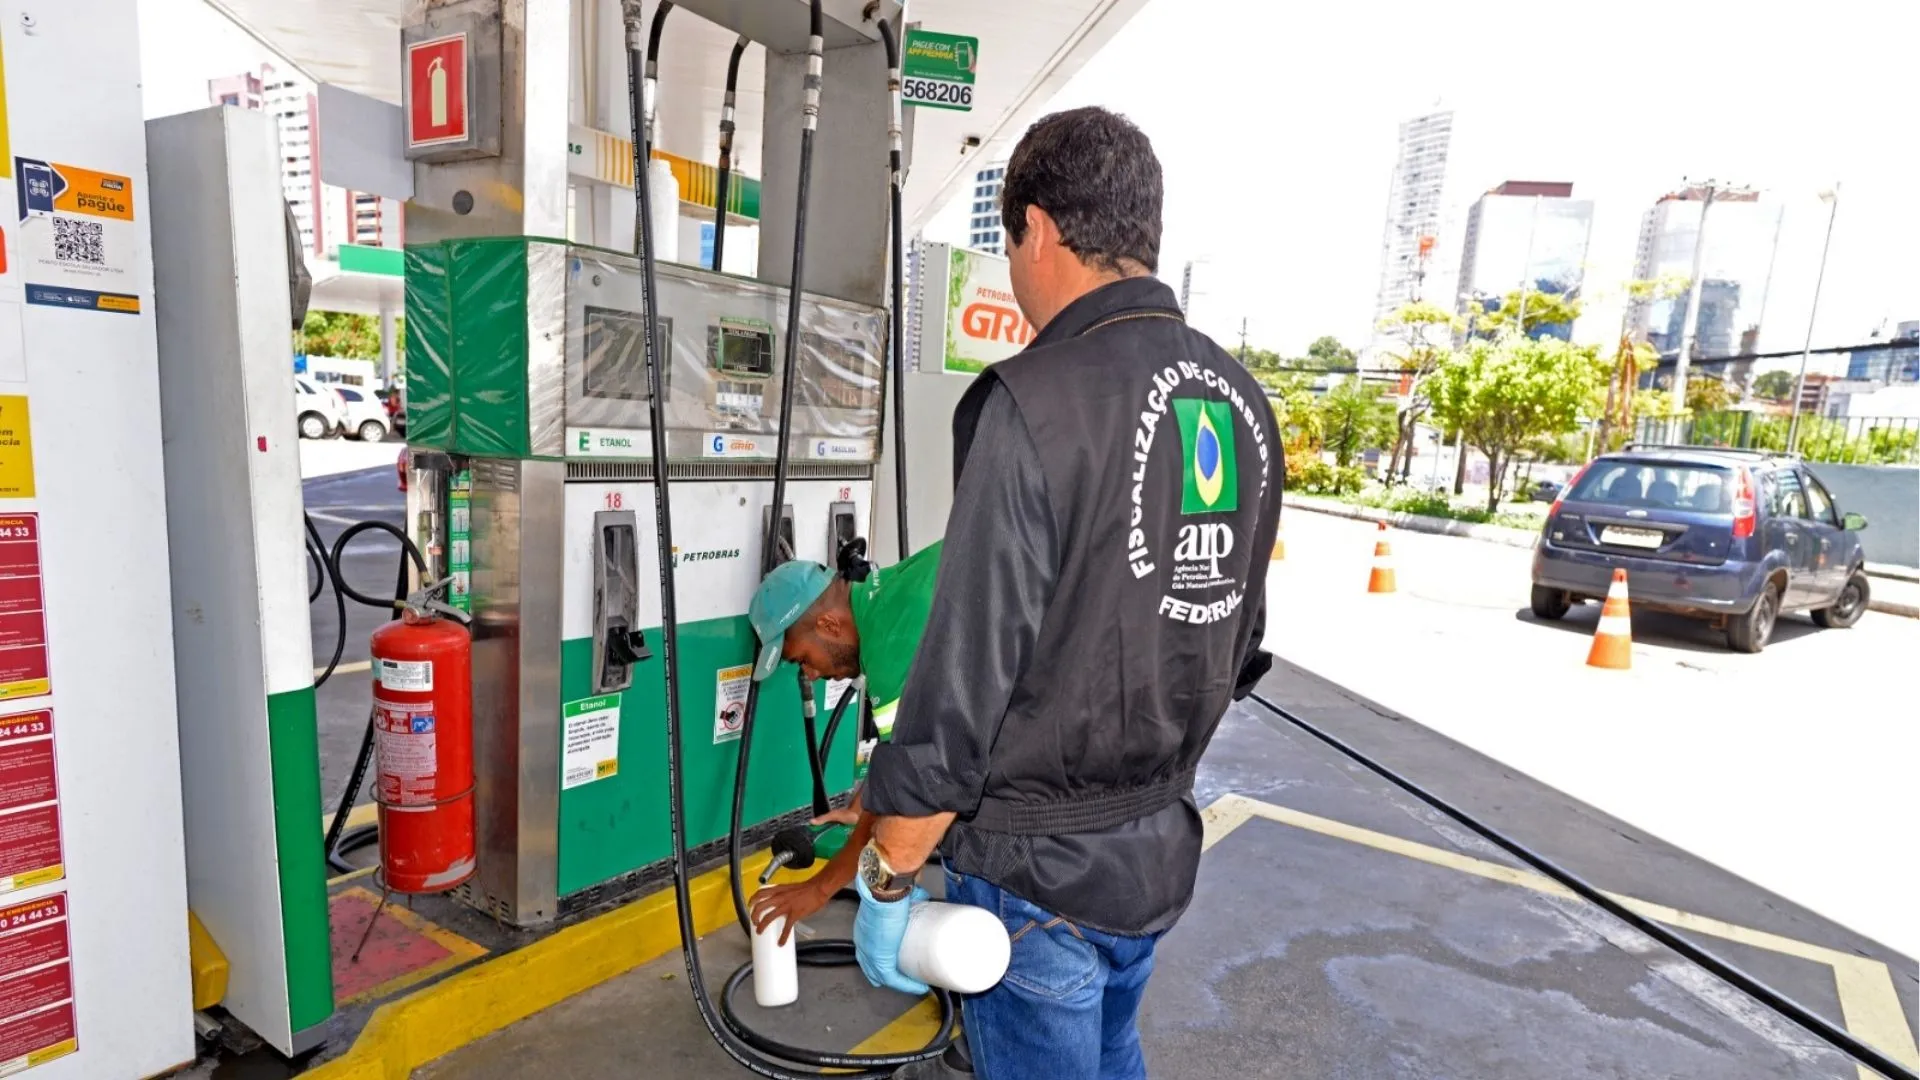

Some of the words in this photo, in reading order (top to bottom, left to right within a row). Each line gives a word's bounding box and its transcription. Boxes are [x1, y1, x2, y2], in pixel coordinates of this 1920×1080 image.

[903, 79, 972, 105] 568206
[77, 198, 125, 212] pague
[976, 287, 1017, 303] PETROBRA
[579, 432, 590, 452] E
[600, 437, 632, 447] ETANOL
[713, 435, 723, 452] G
[817, 441, 825, 456] G
[1128, 366, 1180, 579] FISCALIZAÇÃO
[1177, 360, 1204, 380] DE
[605, 492, 622, 508] 18
[839, 487, 850, 500] 16
[15, 527, 29, 536] 33
[683, 548, 740, 562] PETROBRAS
[1158, 594, 1243, 624] FEDERAL
[580, 699, 607, 711] Etanol
[13, 724, 28, 734] 44
[30, 721, 44, 732] 33
[12, 914, 26, 925] 24
[28, 909, 43, 920] 44
[45, 904, 59, 916] 33
